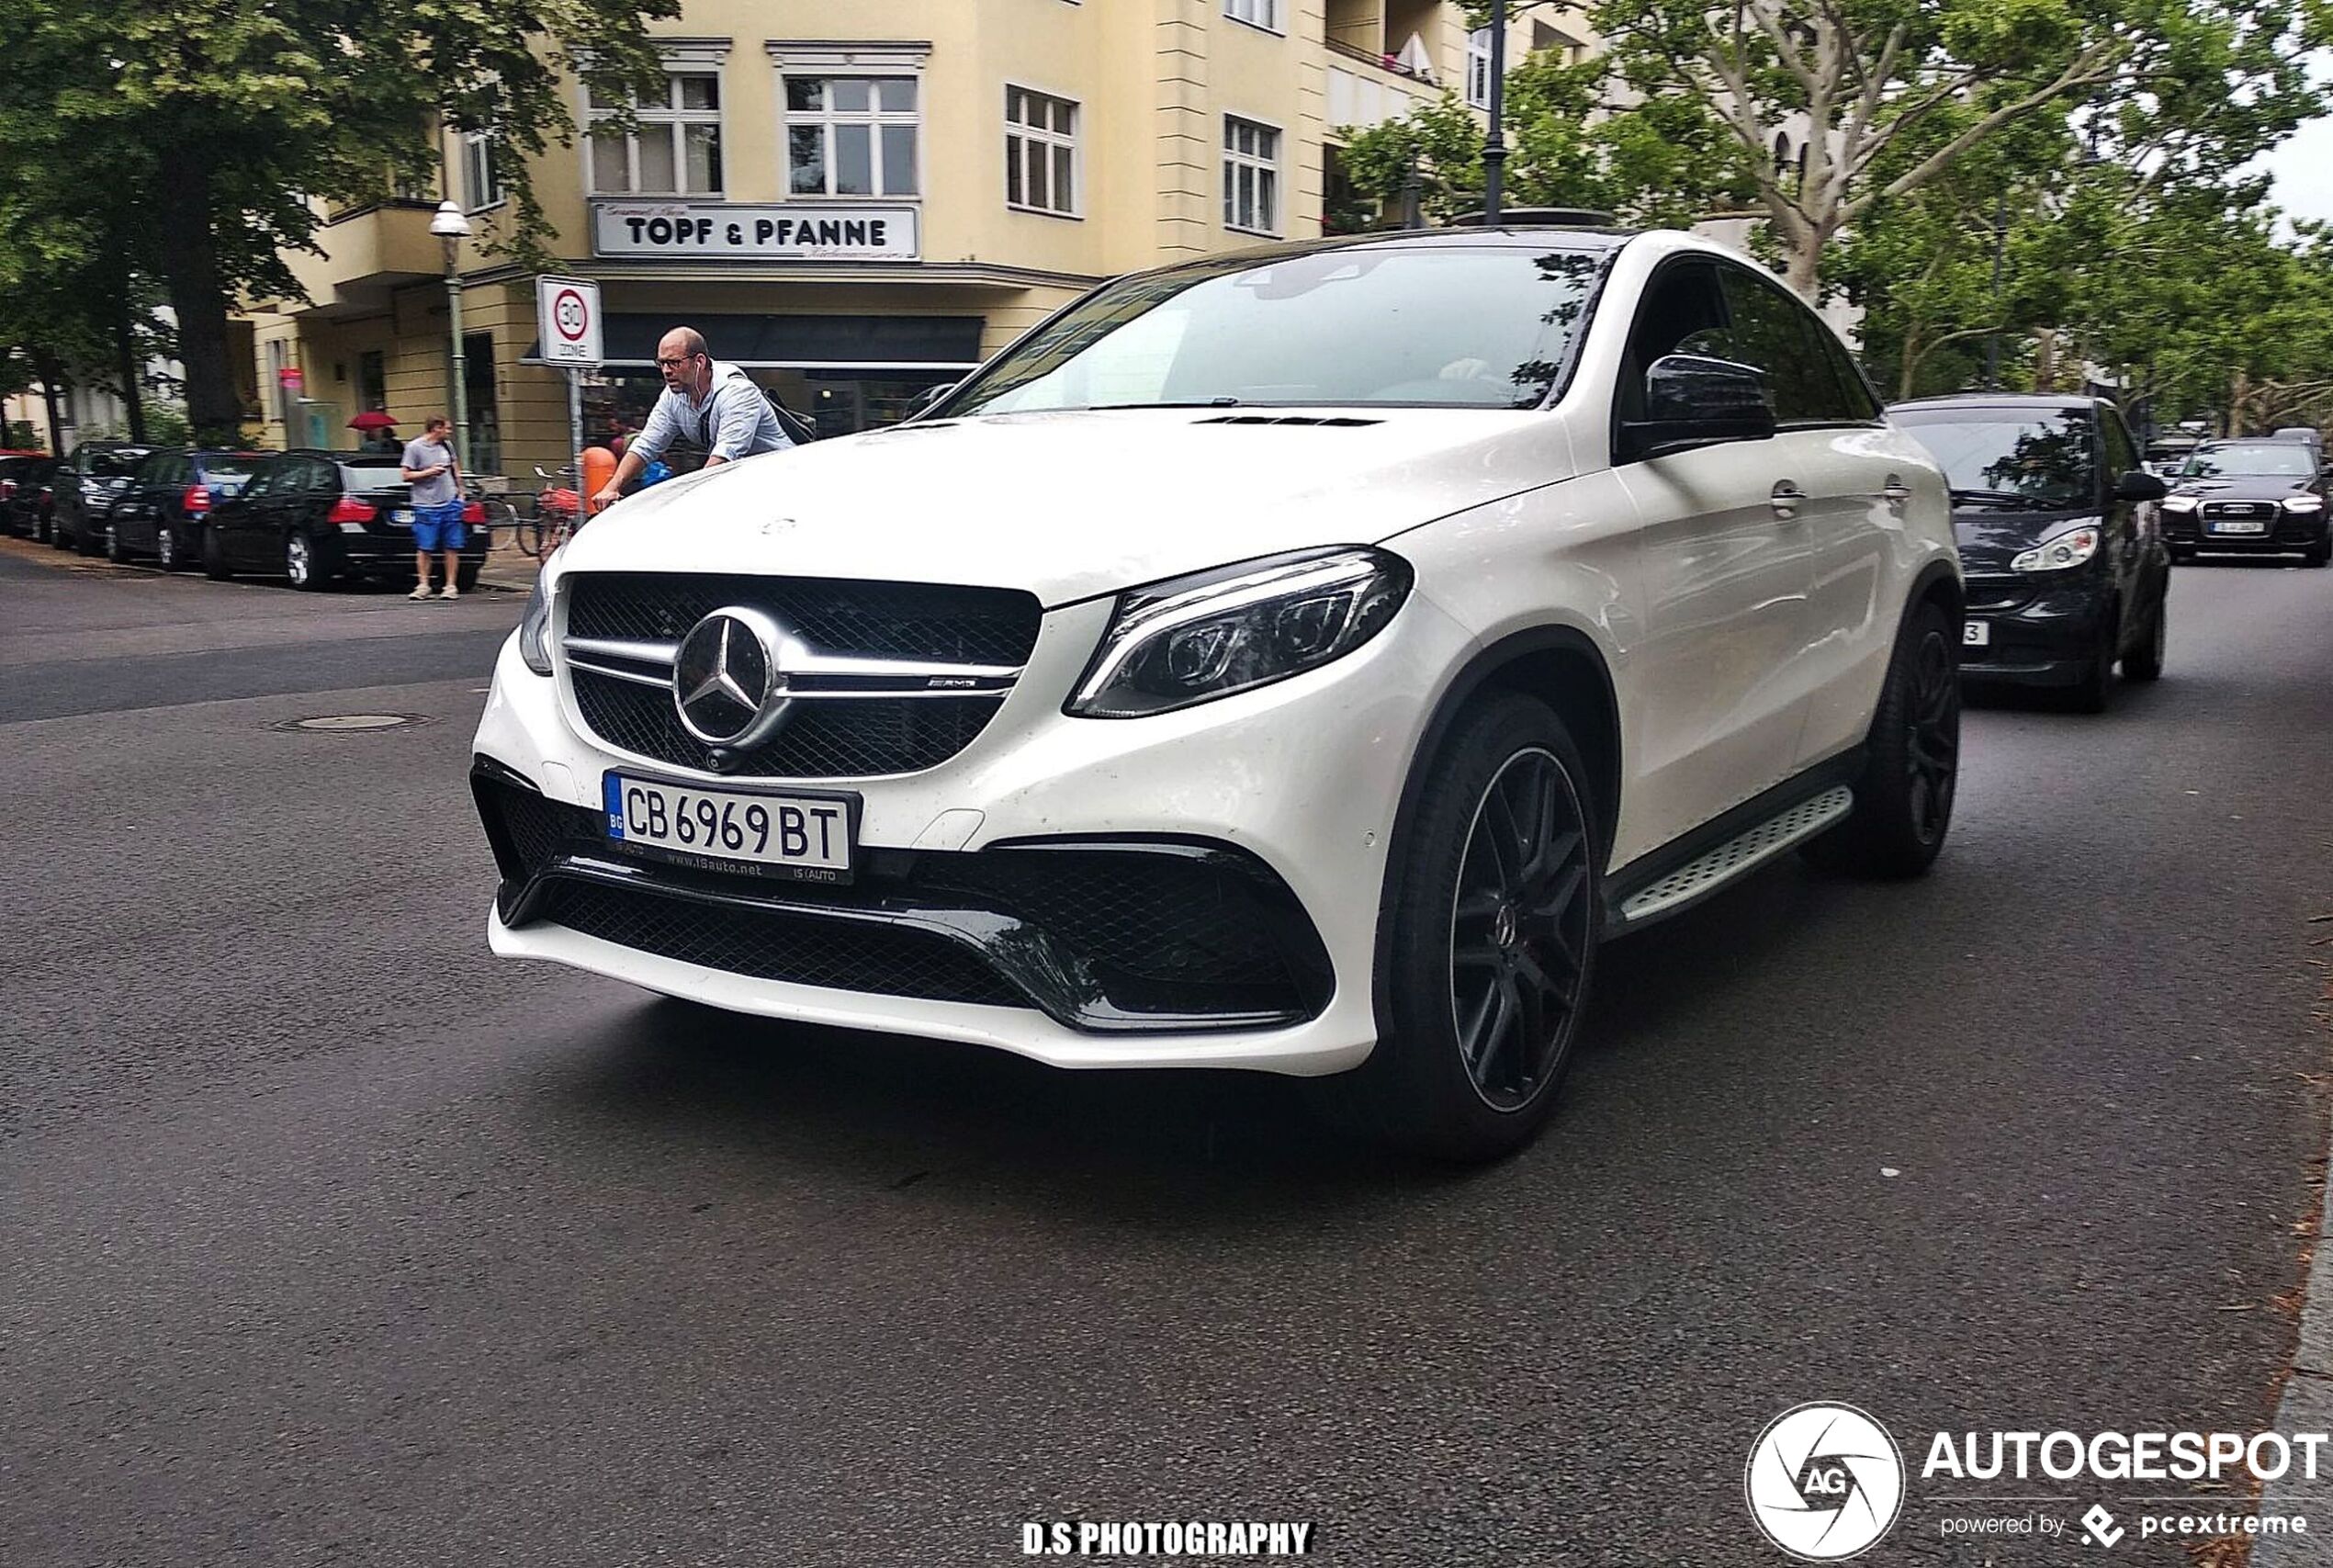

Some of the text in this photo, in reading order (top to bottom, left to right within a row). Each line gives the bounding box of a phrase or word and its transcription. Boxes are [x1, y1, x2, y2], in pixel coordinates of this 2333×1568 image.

[626, 218, 886, 246] TOPF & PFANNE
[559, 302, 583, 327] 30
[1965, 625, 1979, 641] 3
[609, 814, 624, 829] BG
